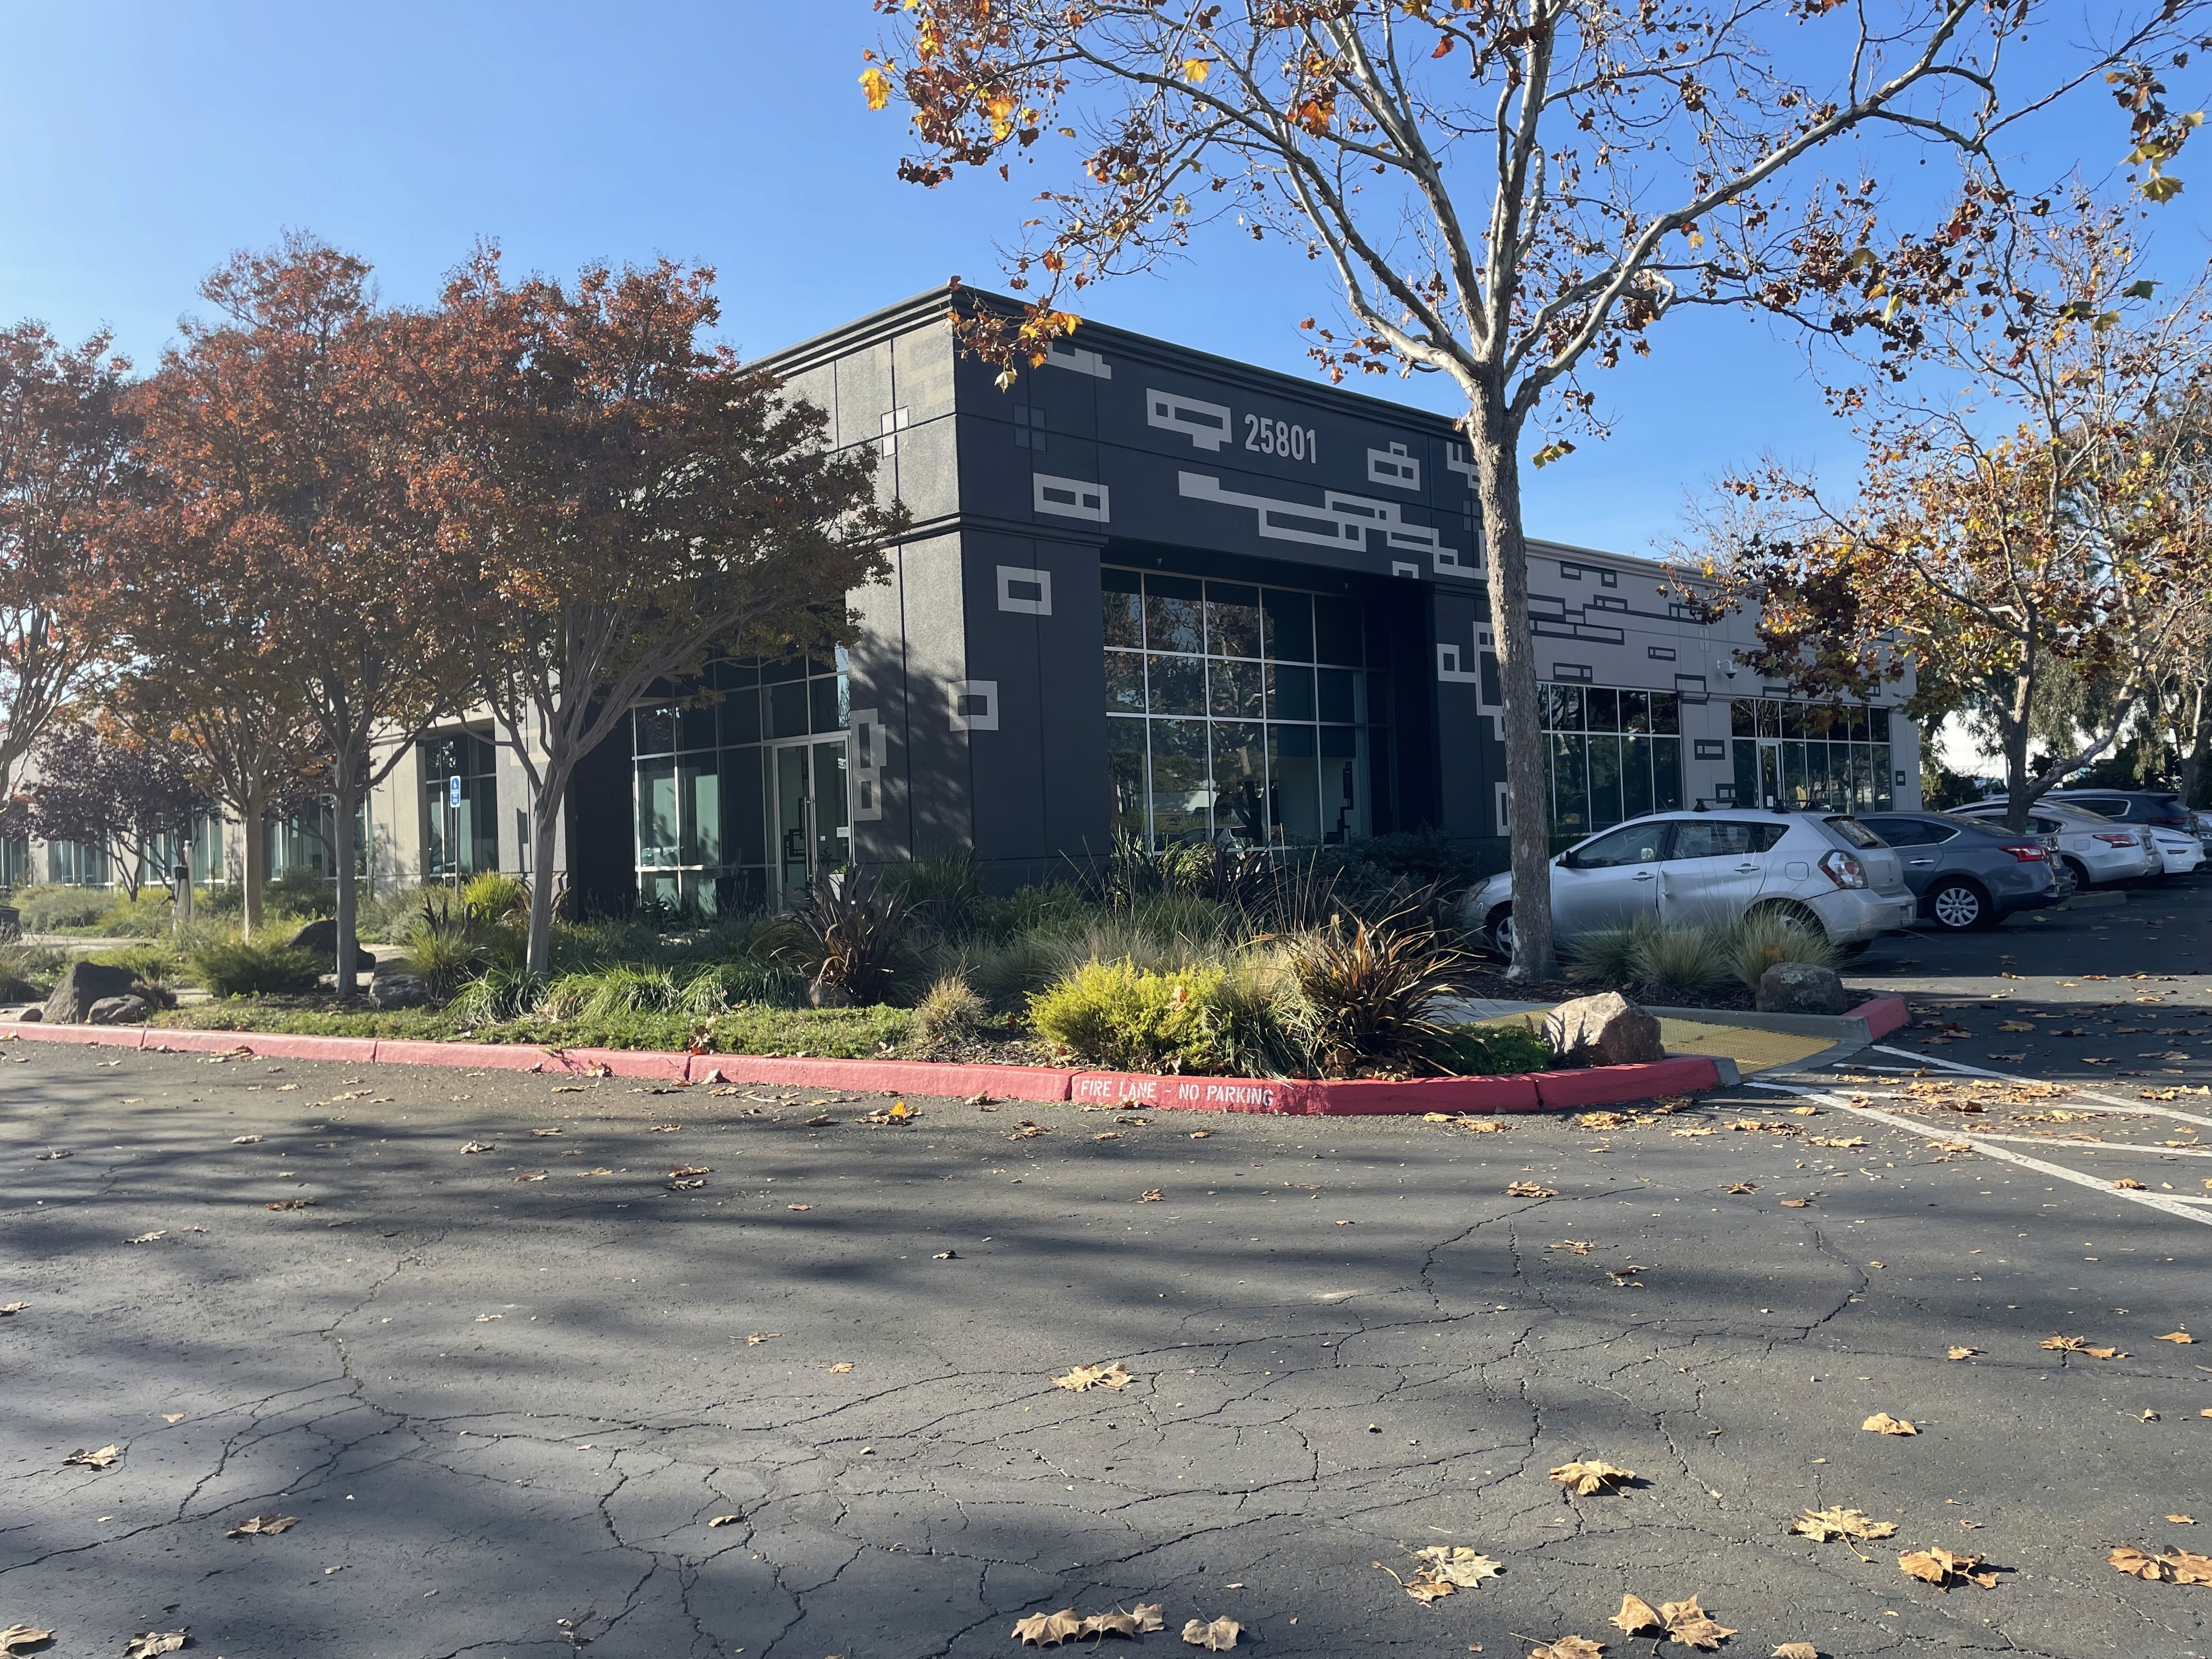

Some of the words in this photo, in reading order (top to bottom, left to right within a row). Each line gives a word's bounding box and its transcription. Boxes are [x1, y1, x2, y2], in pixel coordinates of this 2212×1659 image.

[1244, 413, 1316, 464] 25801
[1081, 1080, 1113, 1097] FIRE
[1119, 1081, 1157, 1098] LANE
[1179, 1083, 1199, 1101] NO
[1207, 1085, 1273, 1107] PARKING
